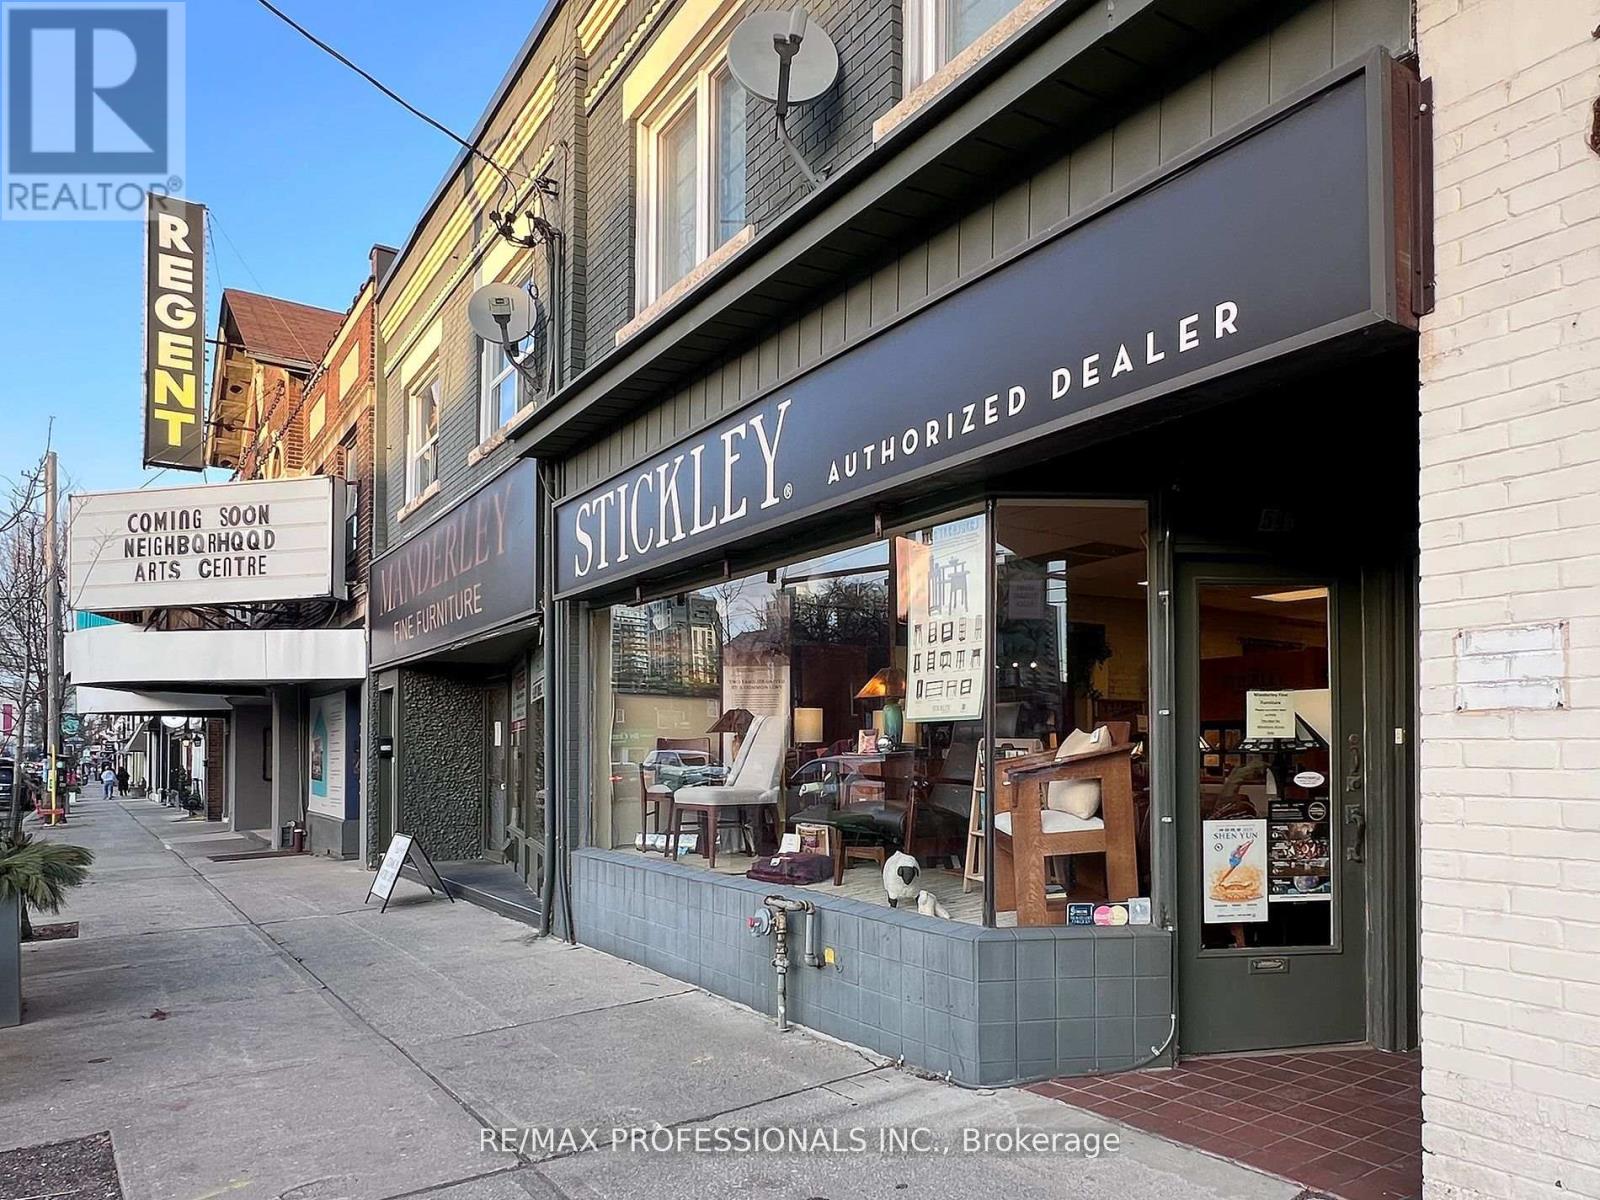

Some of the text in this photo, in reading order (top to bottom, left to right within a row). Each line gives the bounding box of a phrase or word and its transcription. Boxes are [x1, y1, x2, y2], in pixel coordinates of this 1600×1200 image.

[154, 212, 198, 447] REGENT
[827, 300, 1239, 486] AUTHORIZED DEALER
[127, 504, 270, 534] COMING SOON
[135, 555, 267, 582] ARTS CENTRE
[393, 583, 483, 646] FINE FURNITURE
[1240, 831, 1258, 839] YUN
